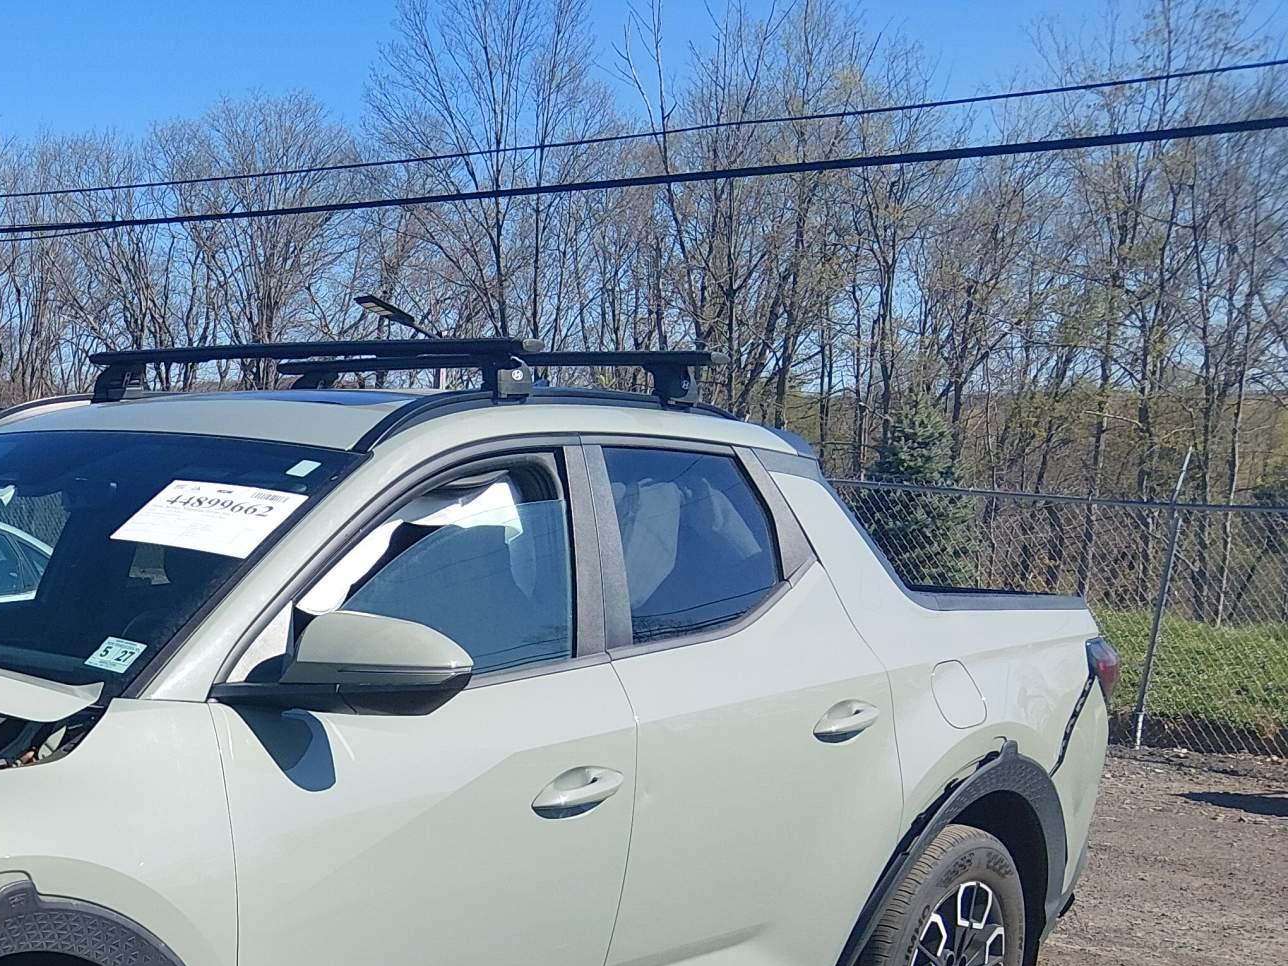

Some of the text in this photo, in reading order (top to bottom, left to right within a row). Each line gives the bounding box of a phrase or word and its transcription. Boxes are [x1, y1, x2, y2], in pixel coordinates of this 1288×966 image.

[166, 494, 275, 517] 44899662
[99, 645, 114, 658] 5
[116, 649, 136, 663] 27
